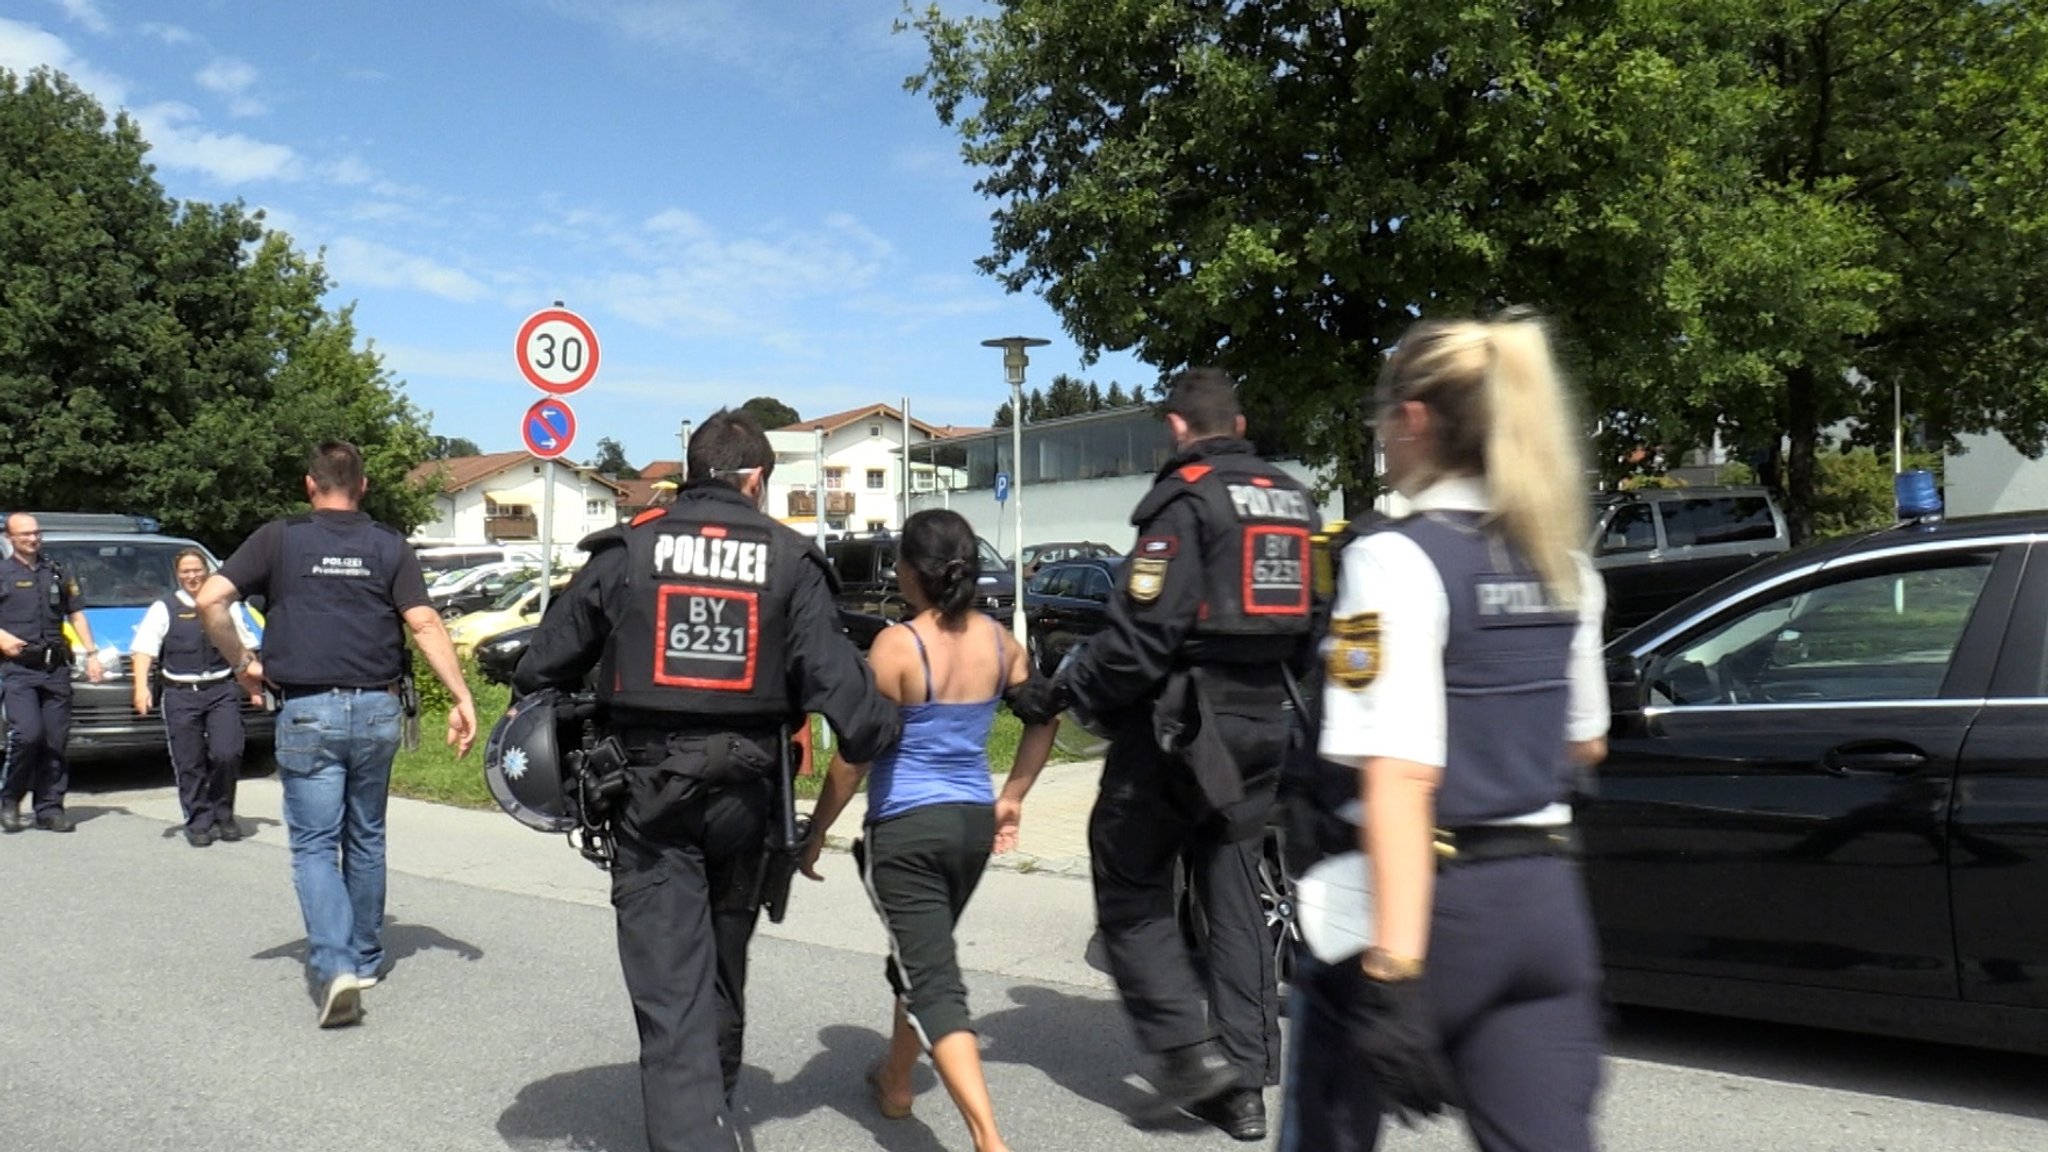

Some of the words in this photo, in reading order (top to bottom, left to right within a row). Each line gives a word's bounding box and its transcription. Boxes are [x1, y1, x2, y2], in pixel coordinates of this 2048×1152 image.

[535, 333, 582, 372] 30
[997, 476, 1006, 497] P
[1227, 485, 1310, 521] POLIZEI
[654, 534, 767, 584] POLIZEI
[1265, 534, 1292, 557] BY
[322, 556, 362, 567] POLIZEI
[689, 596, 727, 624] BY
[670, 622, 746, 654] 6231
